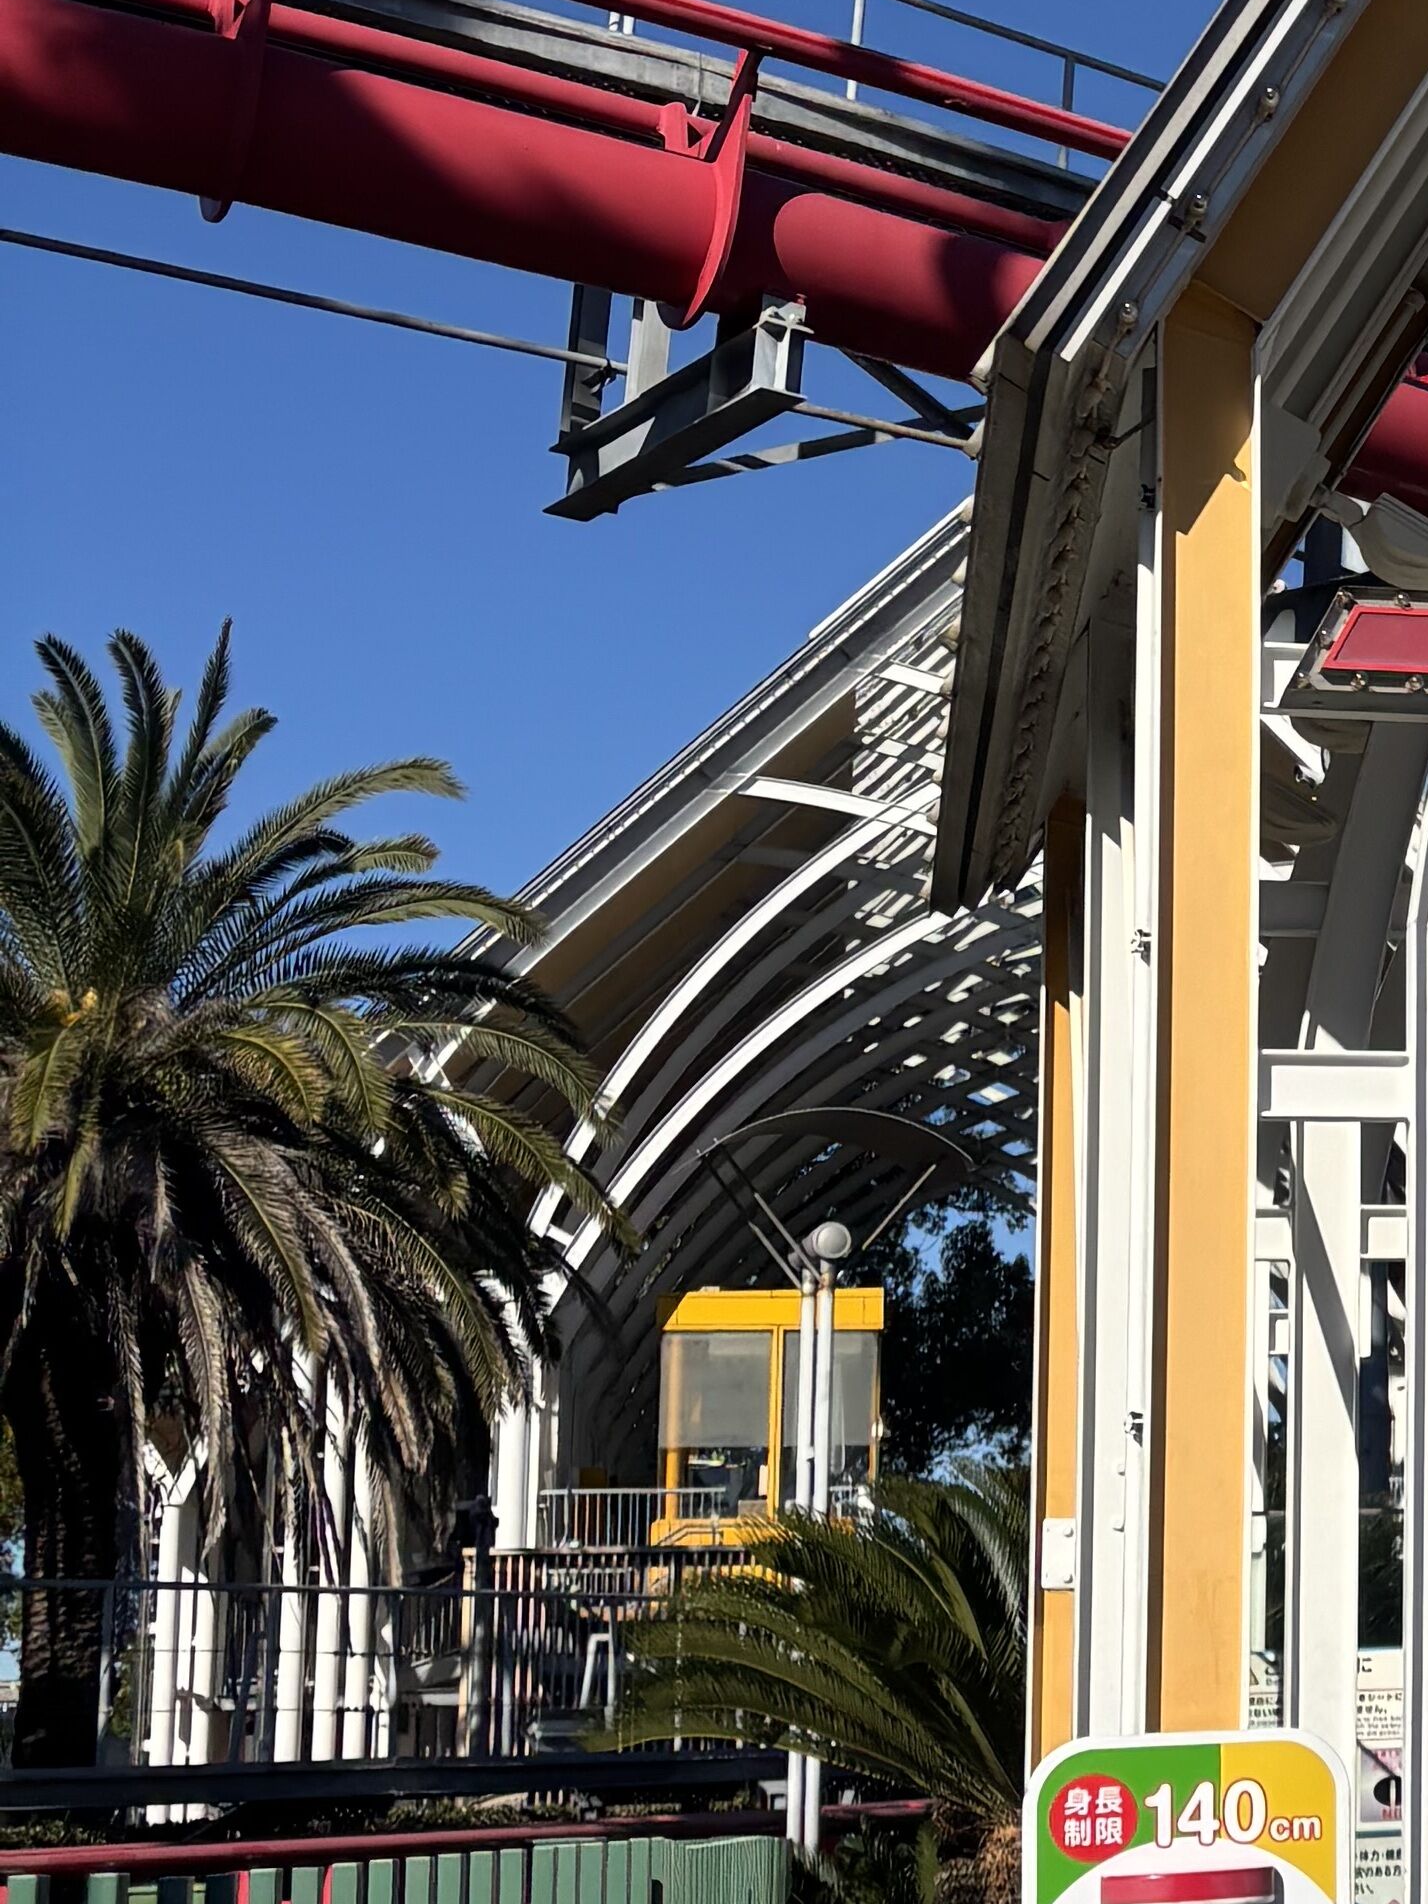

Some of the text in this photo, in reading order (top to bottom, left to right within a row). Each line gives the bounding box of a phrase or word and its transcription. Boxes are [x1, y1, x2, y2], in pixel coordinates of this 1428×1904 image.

[1063, 1785, 1124, 1815] 身長
[1144, 1778, 1322, 1849] 140cm
[1063, 1816, 1124, 1848] 制限
